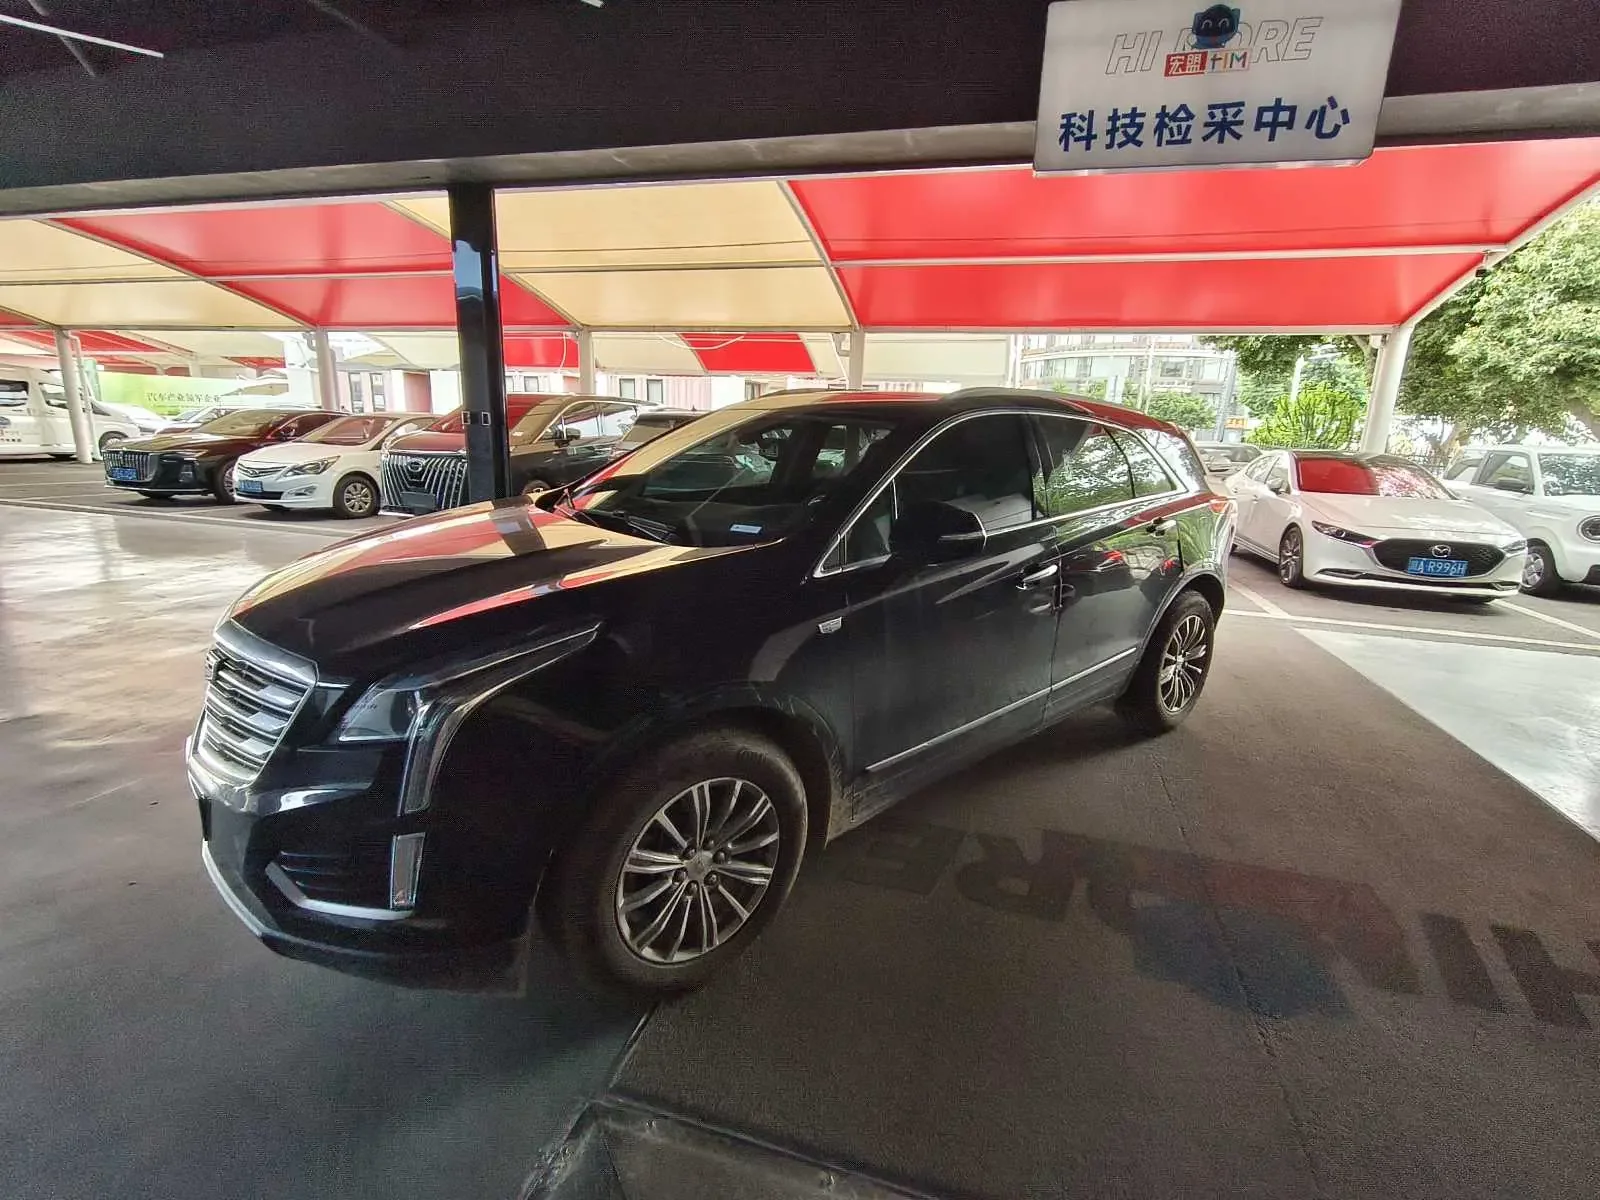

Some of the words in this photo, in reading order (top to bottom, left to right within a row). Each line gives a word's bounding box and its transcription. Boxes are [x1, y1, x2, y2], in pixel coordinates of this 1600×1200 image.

[1105, 30, 1162, 74] HI
[1174, 16, 1324, 63] RE
[1168, 53, 1205, 75] 宏盟
[1058, 95, 1350, 152] 科技检采中心
